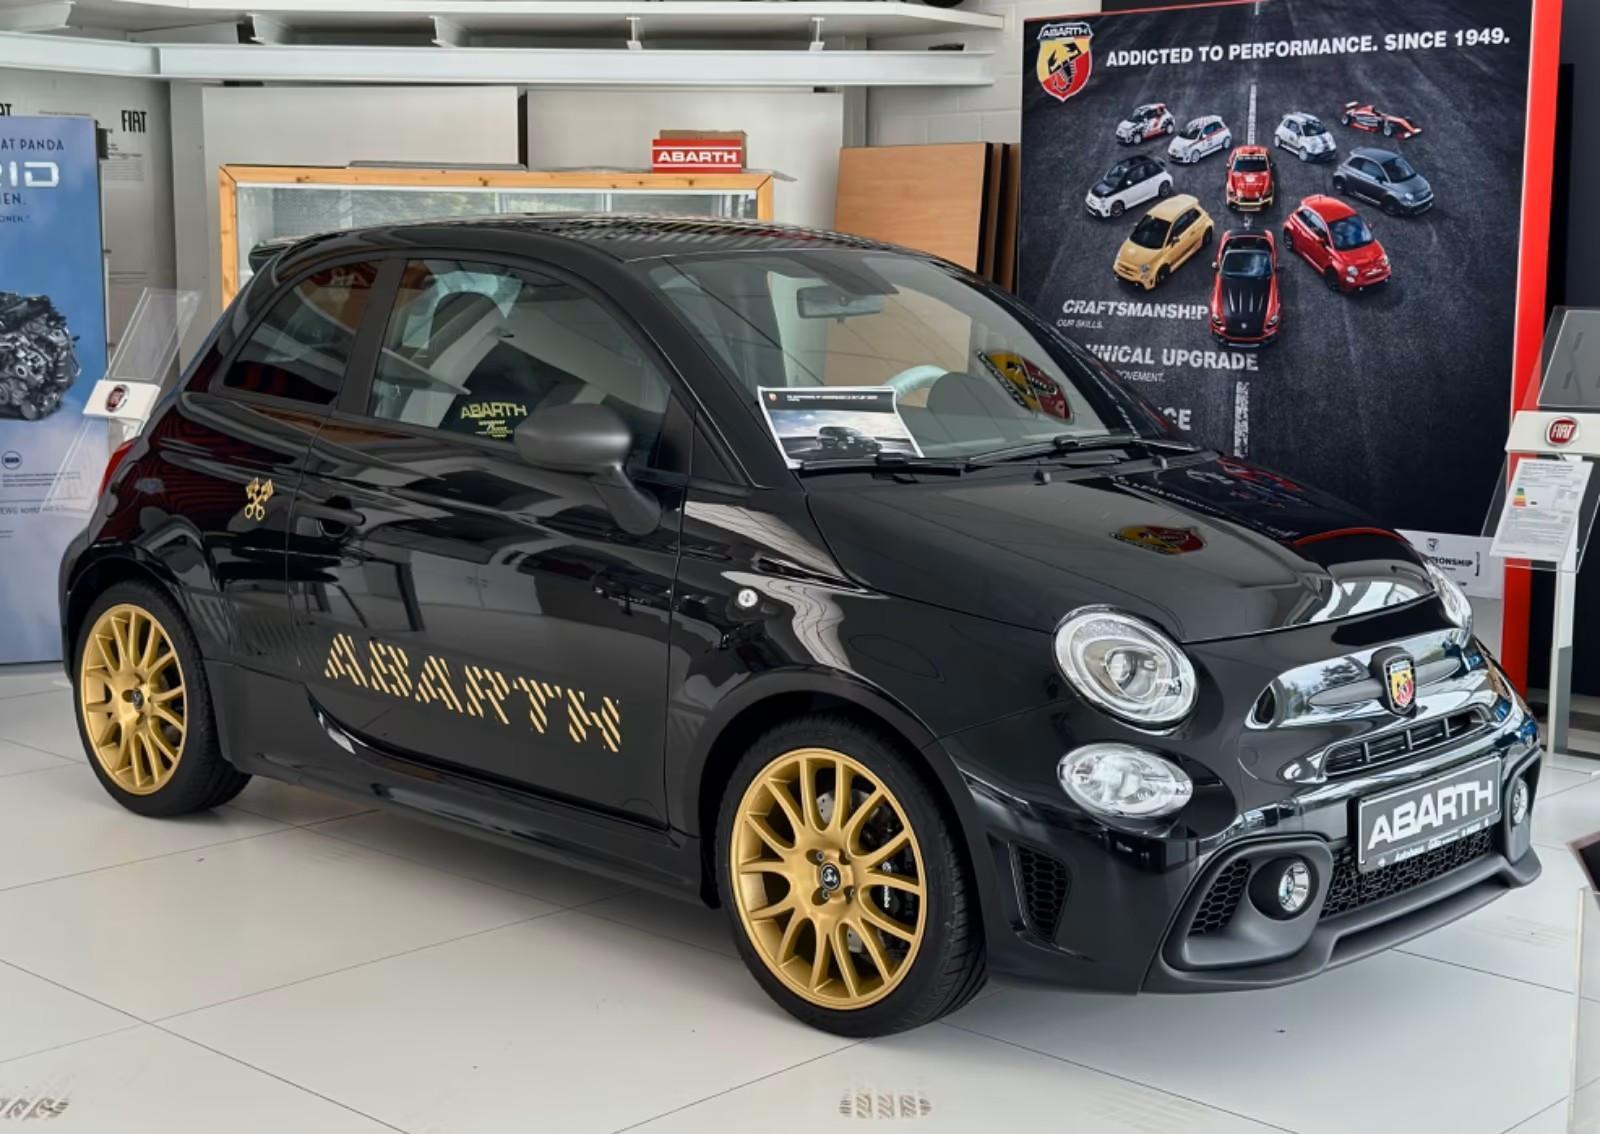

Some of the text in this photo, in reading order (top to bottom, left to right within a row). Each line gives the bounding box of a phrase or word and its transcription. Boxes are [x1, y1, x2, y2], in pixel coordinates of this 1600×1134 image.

[1043, 27, 1089, 37] ABARTH
[1106, 27, 1511, 67] ADDICTED TO PERFORMANCE. SINCE 1949.
[121, 110, 147, 133] FIAT
[20, 139, 64, 151] PANDA
[657, 151, 738, 163] ABARTH
[0, 161, 59, 187] ID
[1062, 299, 1209, 320] CRAFTSMANSHIP
[1162, 348, 1259, 371] UPGRADE
[460, 402, 528, 419] ABARTH
[1551, 423, 1575, 439] FIAT
[324, 632, 622, 752] ABARTH
[1367, 780, 1494, 850] ABARTH
